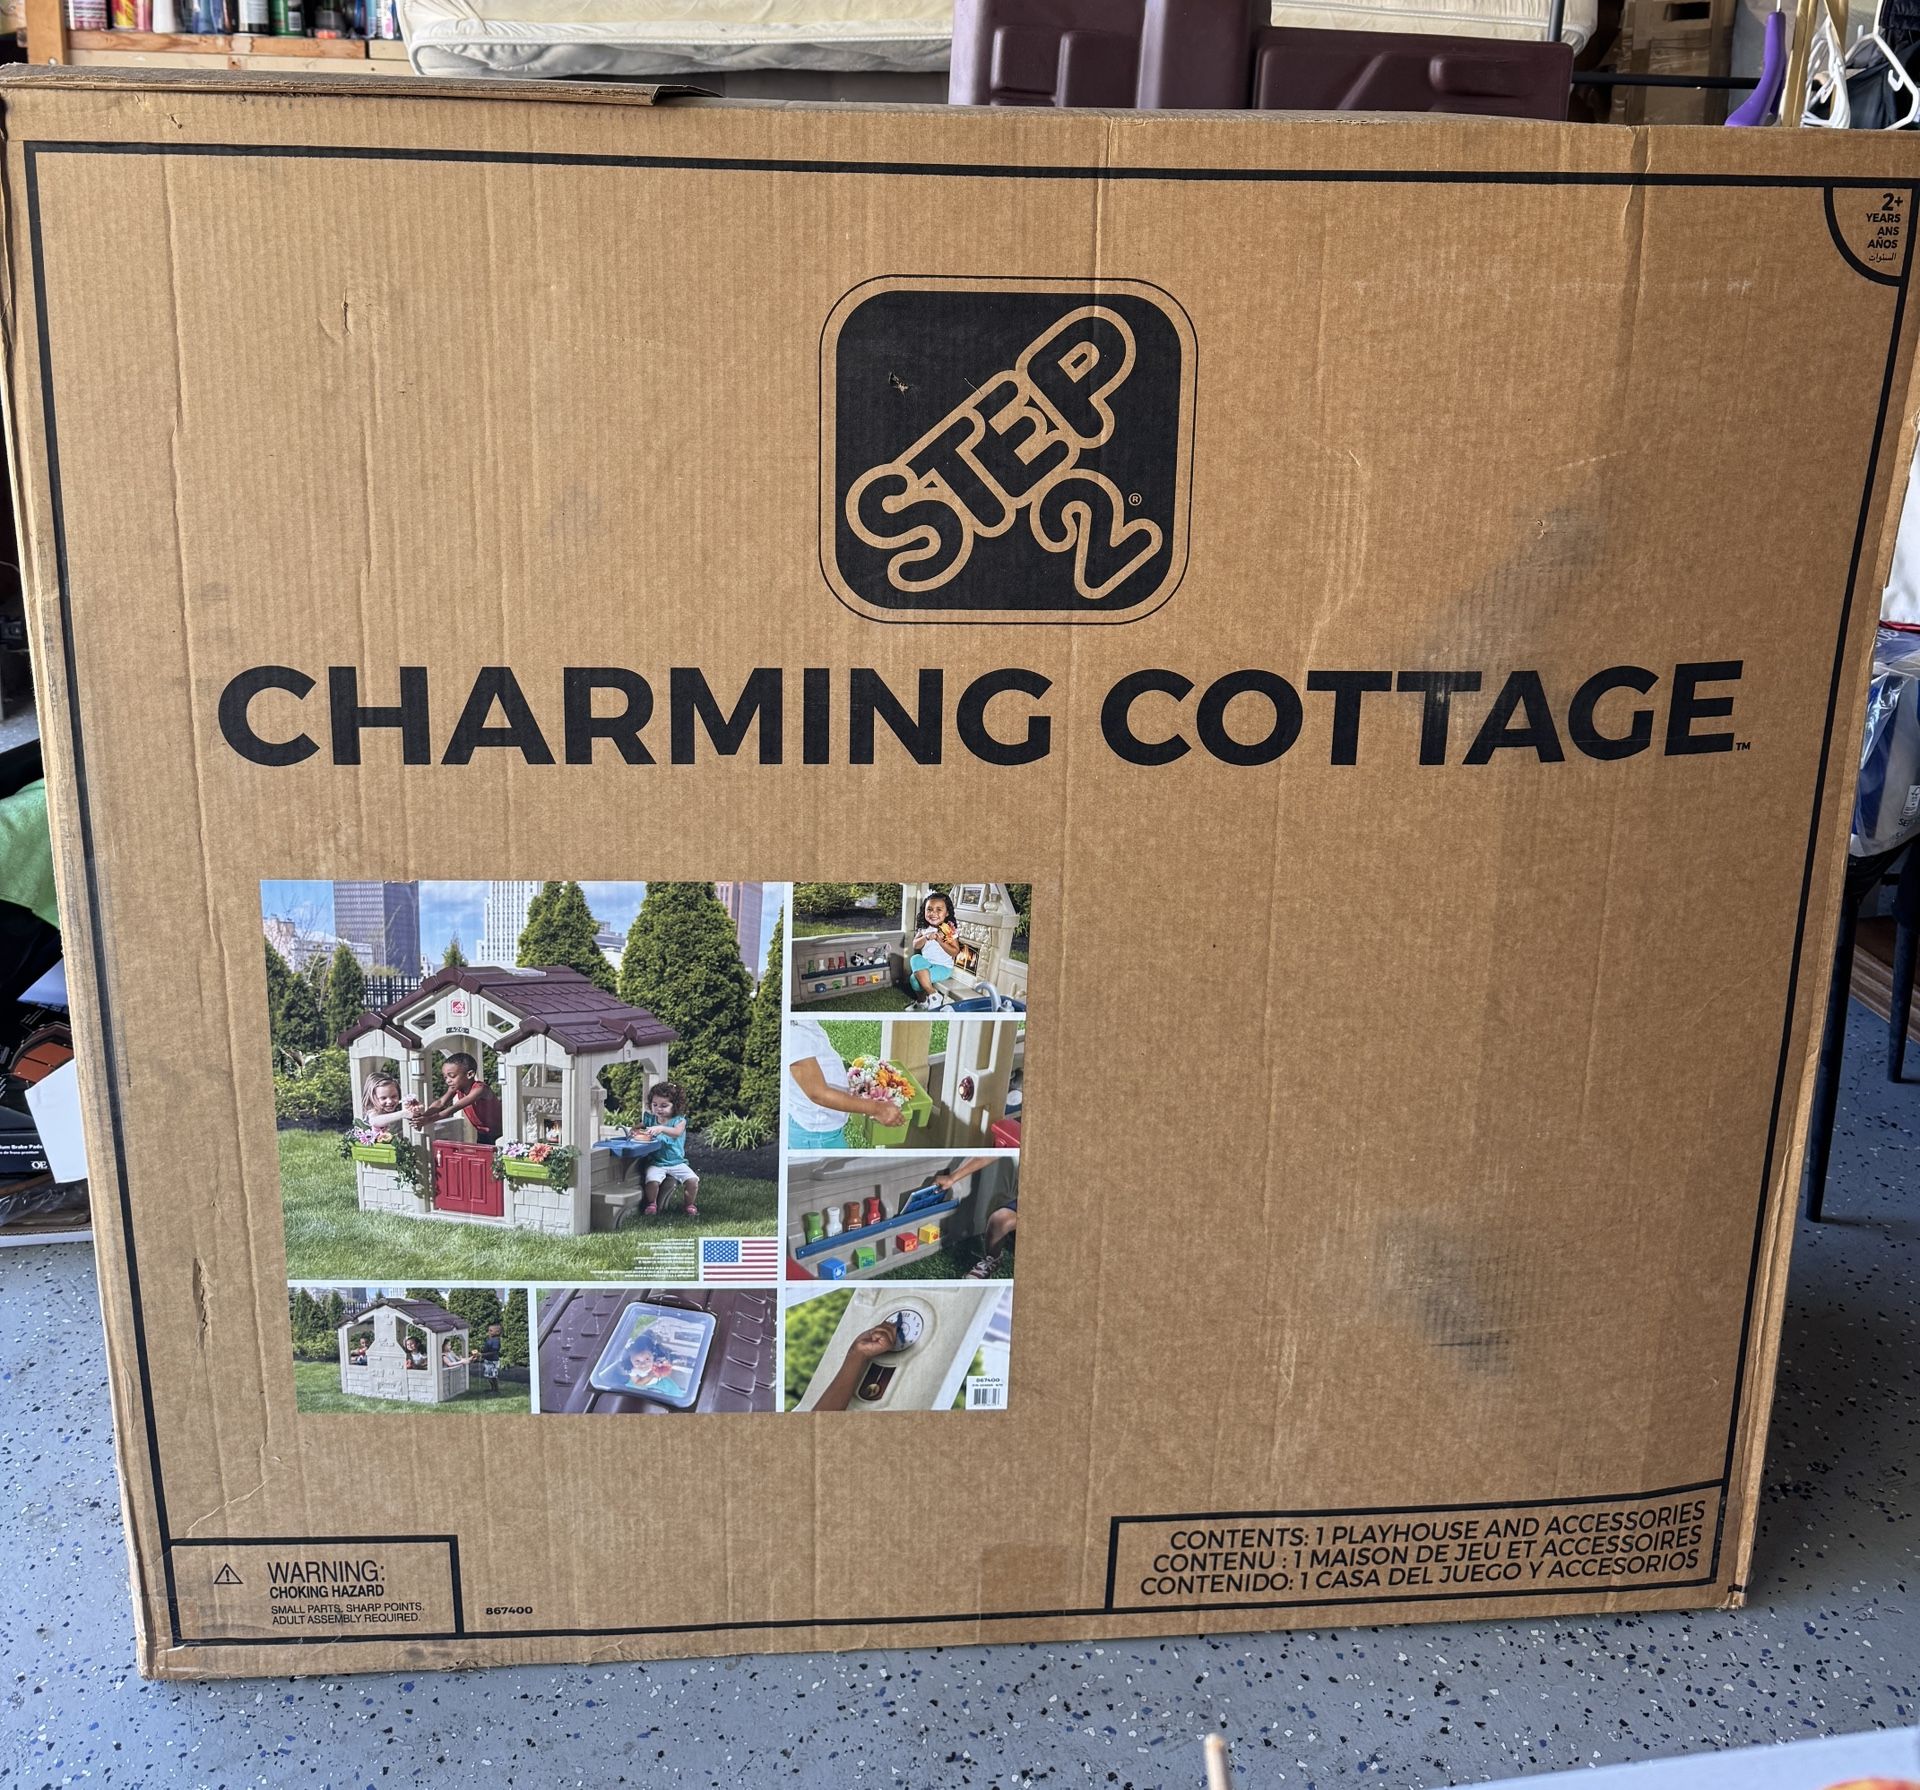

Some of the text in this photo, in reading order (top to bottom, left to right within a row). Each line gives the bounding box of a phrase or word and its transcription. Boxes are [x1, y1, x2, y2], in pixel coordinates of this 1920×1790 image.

[1881, 192, 1903, 211] 2+
[1866, 212, 1901, 223] YEARS
[1877, 226, 1900, 235] ANS
[1867, 236, 1898, 249] AÑOS
[846, 306, 1137, 592] STEP
[219, 666, 1051, 766] CHARMING
[1170, 1500, 1706, 1550] CONTENTS: 1 PLAYHOUSE AND ACCESSORIES
[1153, 1551, 1276, 1573] CONTENU
[1294, 1550, 1302, 1568] 1
[1309, 1546, 1409, 1568] MAISON
[1416, 1545, 1450, 1563] DE
[1454, 1541, 1501, 1562] JEU
[1507, 1539, 1538, 1559] ET
[1541, 1525, 1703, 1557] ACCESSOIRES
[267, 1560, 386, 1584] WARNING:
[1140, 1549, 1699, 1595] CONTENIDO: 1 CASA DEL JUEGO Y ACCESORIOS
[269, 1584, 385, 1599] CHOKING HAZARD
[271, 1602, 425, 1614] SMALL PARTS. SHARP POINTS.
[485, 1606, 533, 1615] 867400
[272, 1612, 421, 1625] ADULT ASSEMBLY REQUIRED.
